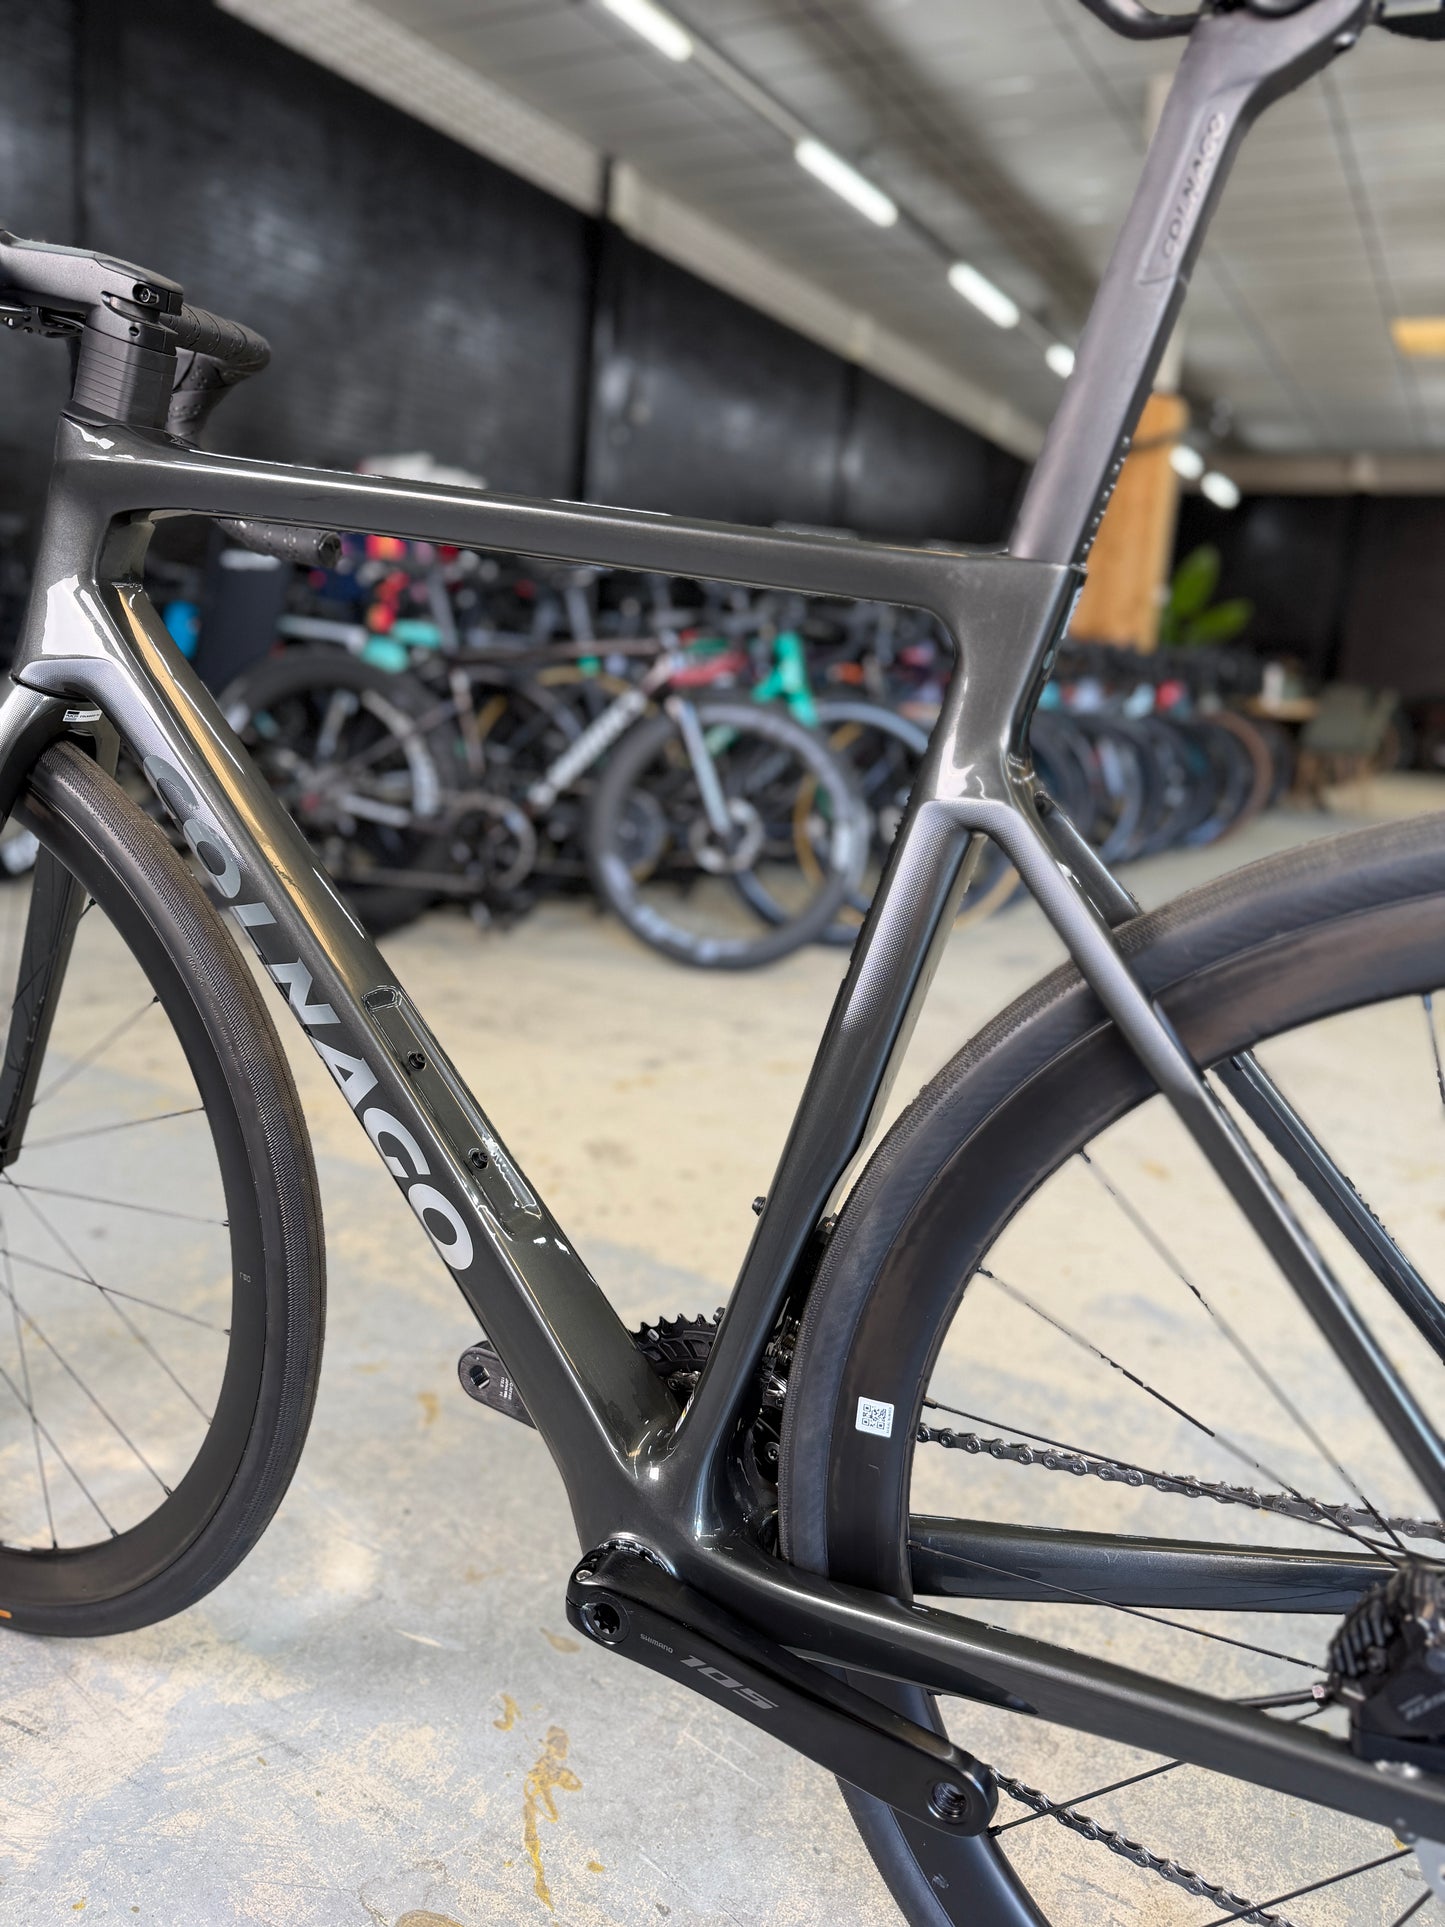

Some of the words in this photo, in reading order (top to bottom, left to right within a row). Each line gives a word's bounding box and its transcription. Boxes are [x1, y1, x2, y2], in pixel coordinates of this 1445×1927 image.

[1162, 111, 1226, 259] COLNAGO
[143, 754, 474, 1271] COLNAGO
[640, 1633, 674, 1654] SHIMANO
[679, 1654, 779, 1710] 105
